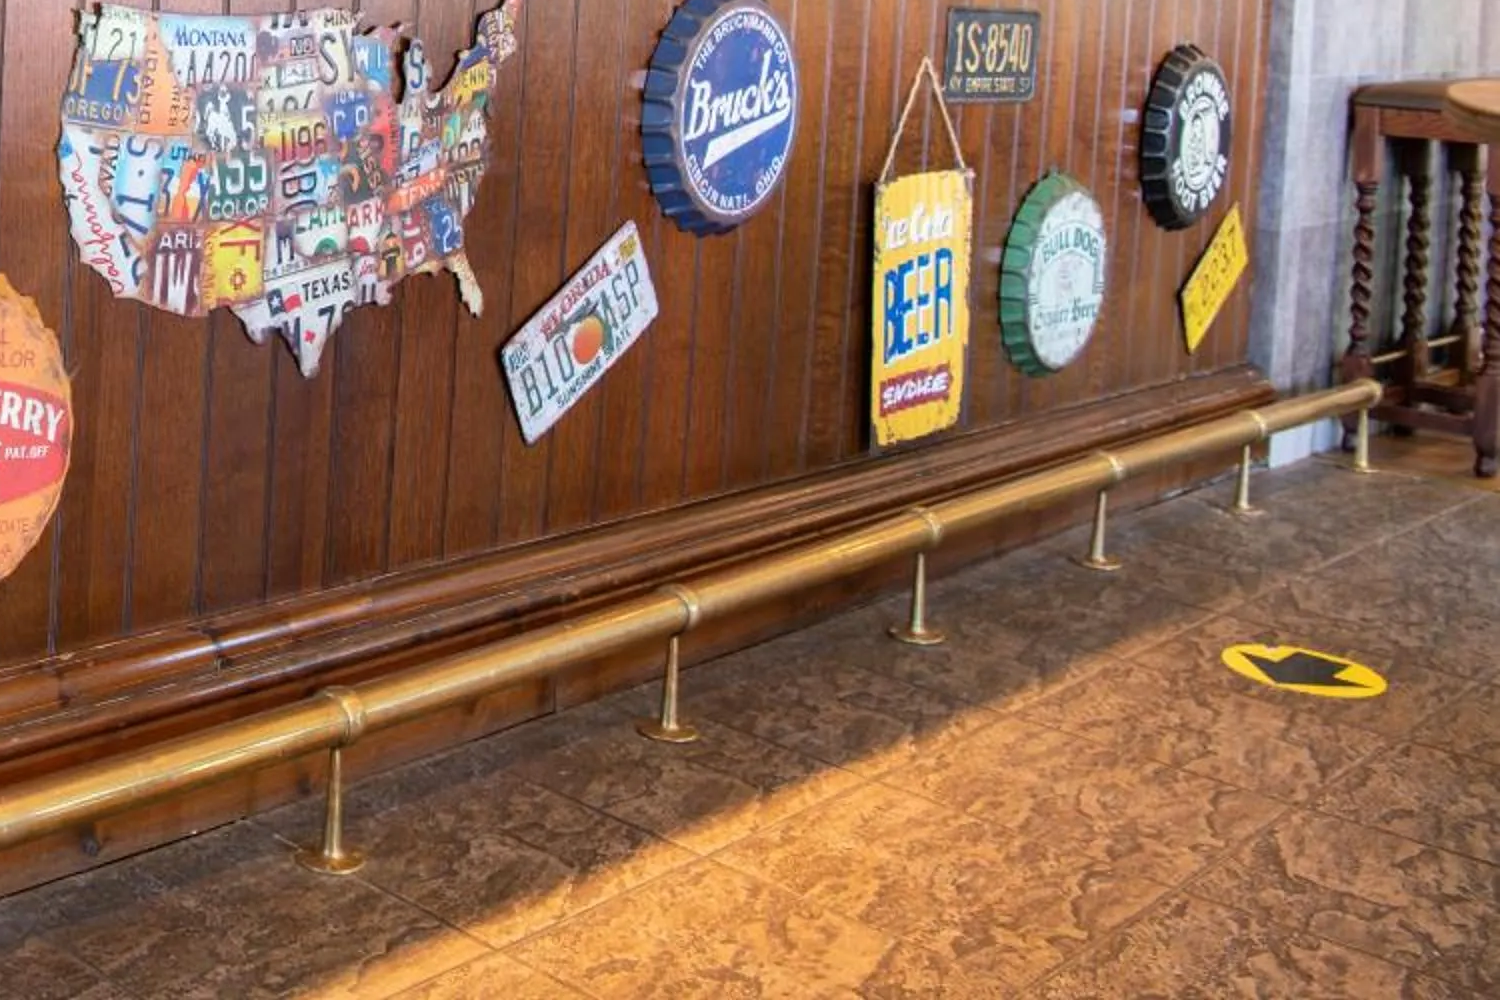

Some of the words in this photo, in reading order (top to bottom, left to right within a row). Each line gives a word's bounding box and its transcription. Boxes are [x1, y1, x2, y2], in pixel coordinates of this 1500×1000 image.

[174, 24, 248, 48] MONTANA
[695, 35, 716, 70] THE
[140, 49, 158, 125] IDAHO
[685, 48, 791, 142] Bruck's
[301, 271, 350, 301] TEXAS
[883, 247, 954, 366] BEER
[604, 329, 632, 362] SATE
